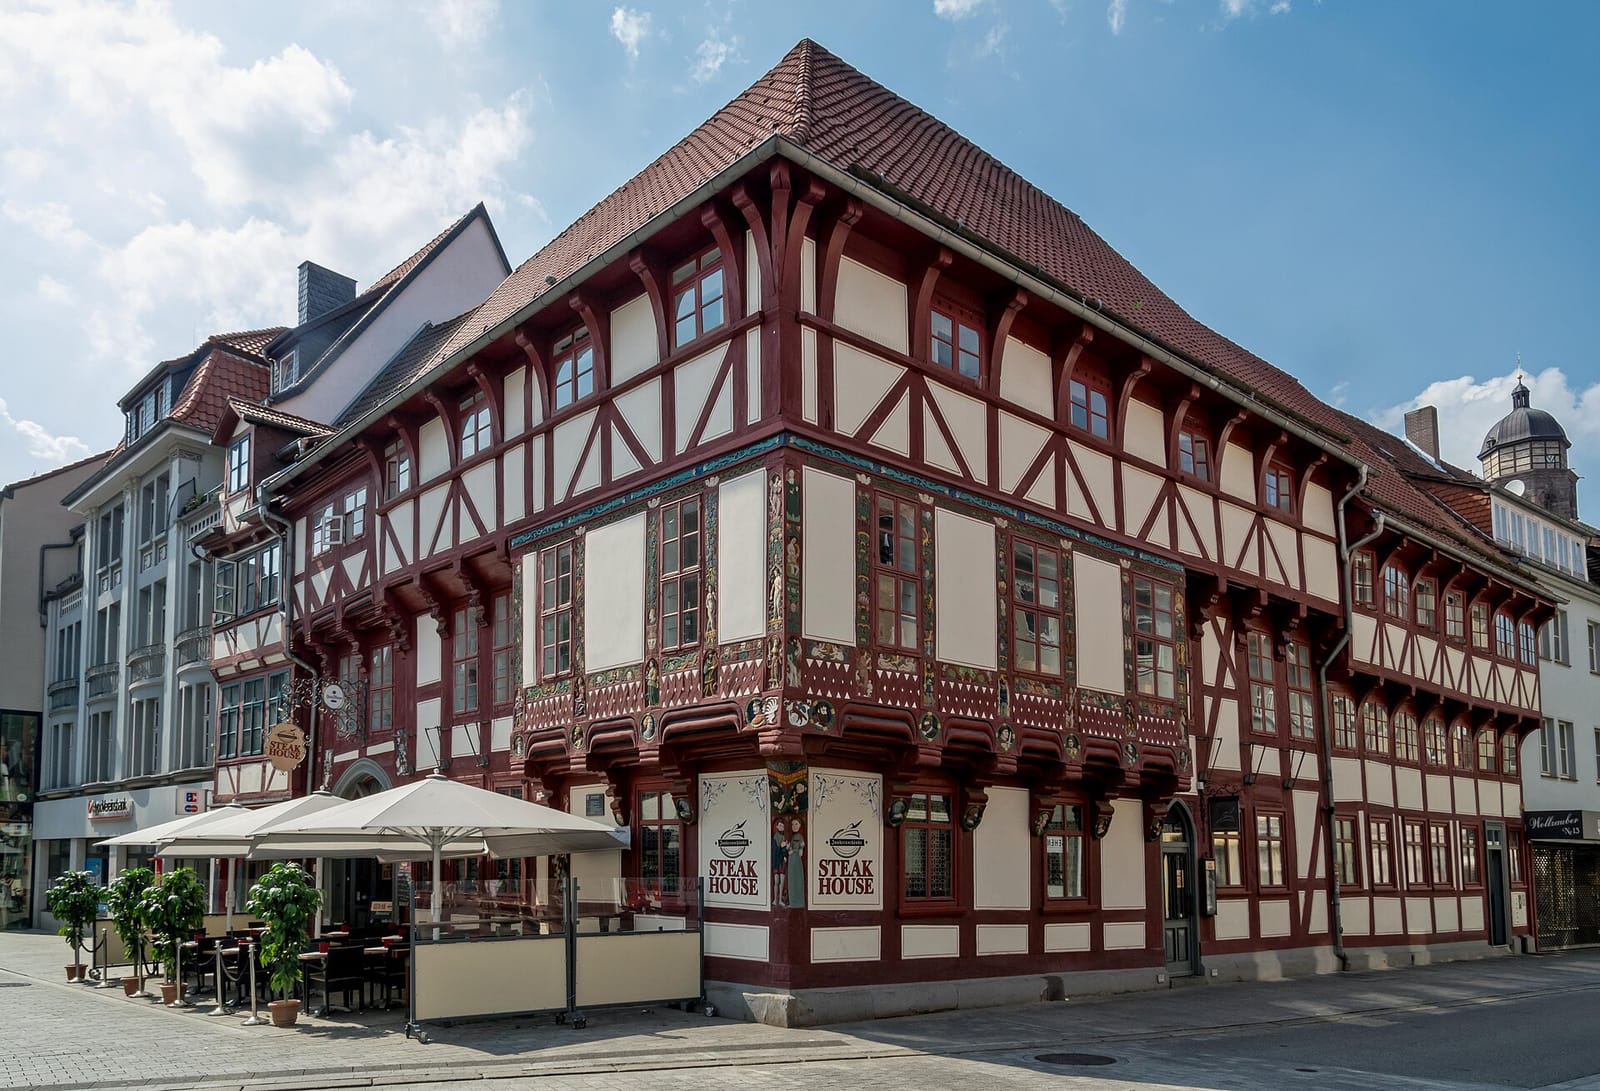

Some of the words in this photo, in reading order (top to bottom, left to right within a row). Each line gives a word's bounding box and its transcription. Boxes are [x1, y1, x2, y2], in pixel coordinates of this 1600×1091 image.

[269, 747, 301, 760] HOUSE
[270, 740, 301, 753] STEAK
[709, 859, 758, 878] STEAK
[819, 859, 874, 878] STEAK
[709, 877, 759, 896] HOUSE
[818, 877, 874, 895] HOUSE
